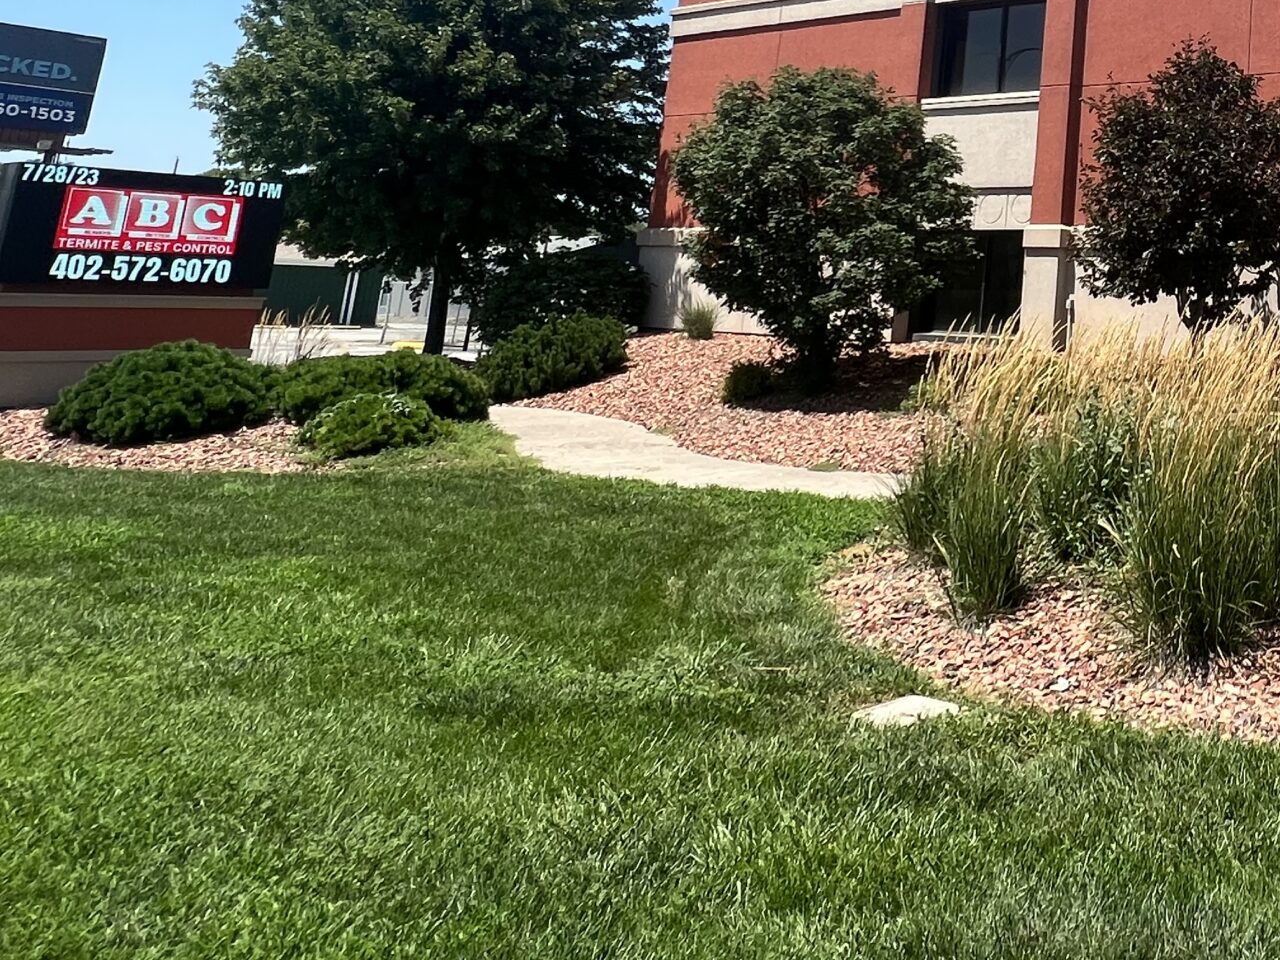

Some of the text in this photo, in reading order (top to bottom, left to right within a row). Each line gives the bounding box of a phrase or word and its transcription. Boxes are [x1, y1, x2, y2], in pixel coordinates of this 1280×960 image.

[22, 163, 99, 186] 7/28/23
[223, 180, 282, 200] 2:10 PM
[69, 195, 226, 231] A B C
[58, 237, 233, 255] TERMITE & PEST CONTROL
[49, 253, 232, 284] 402-572-6070
